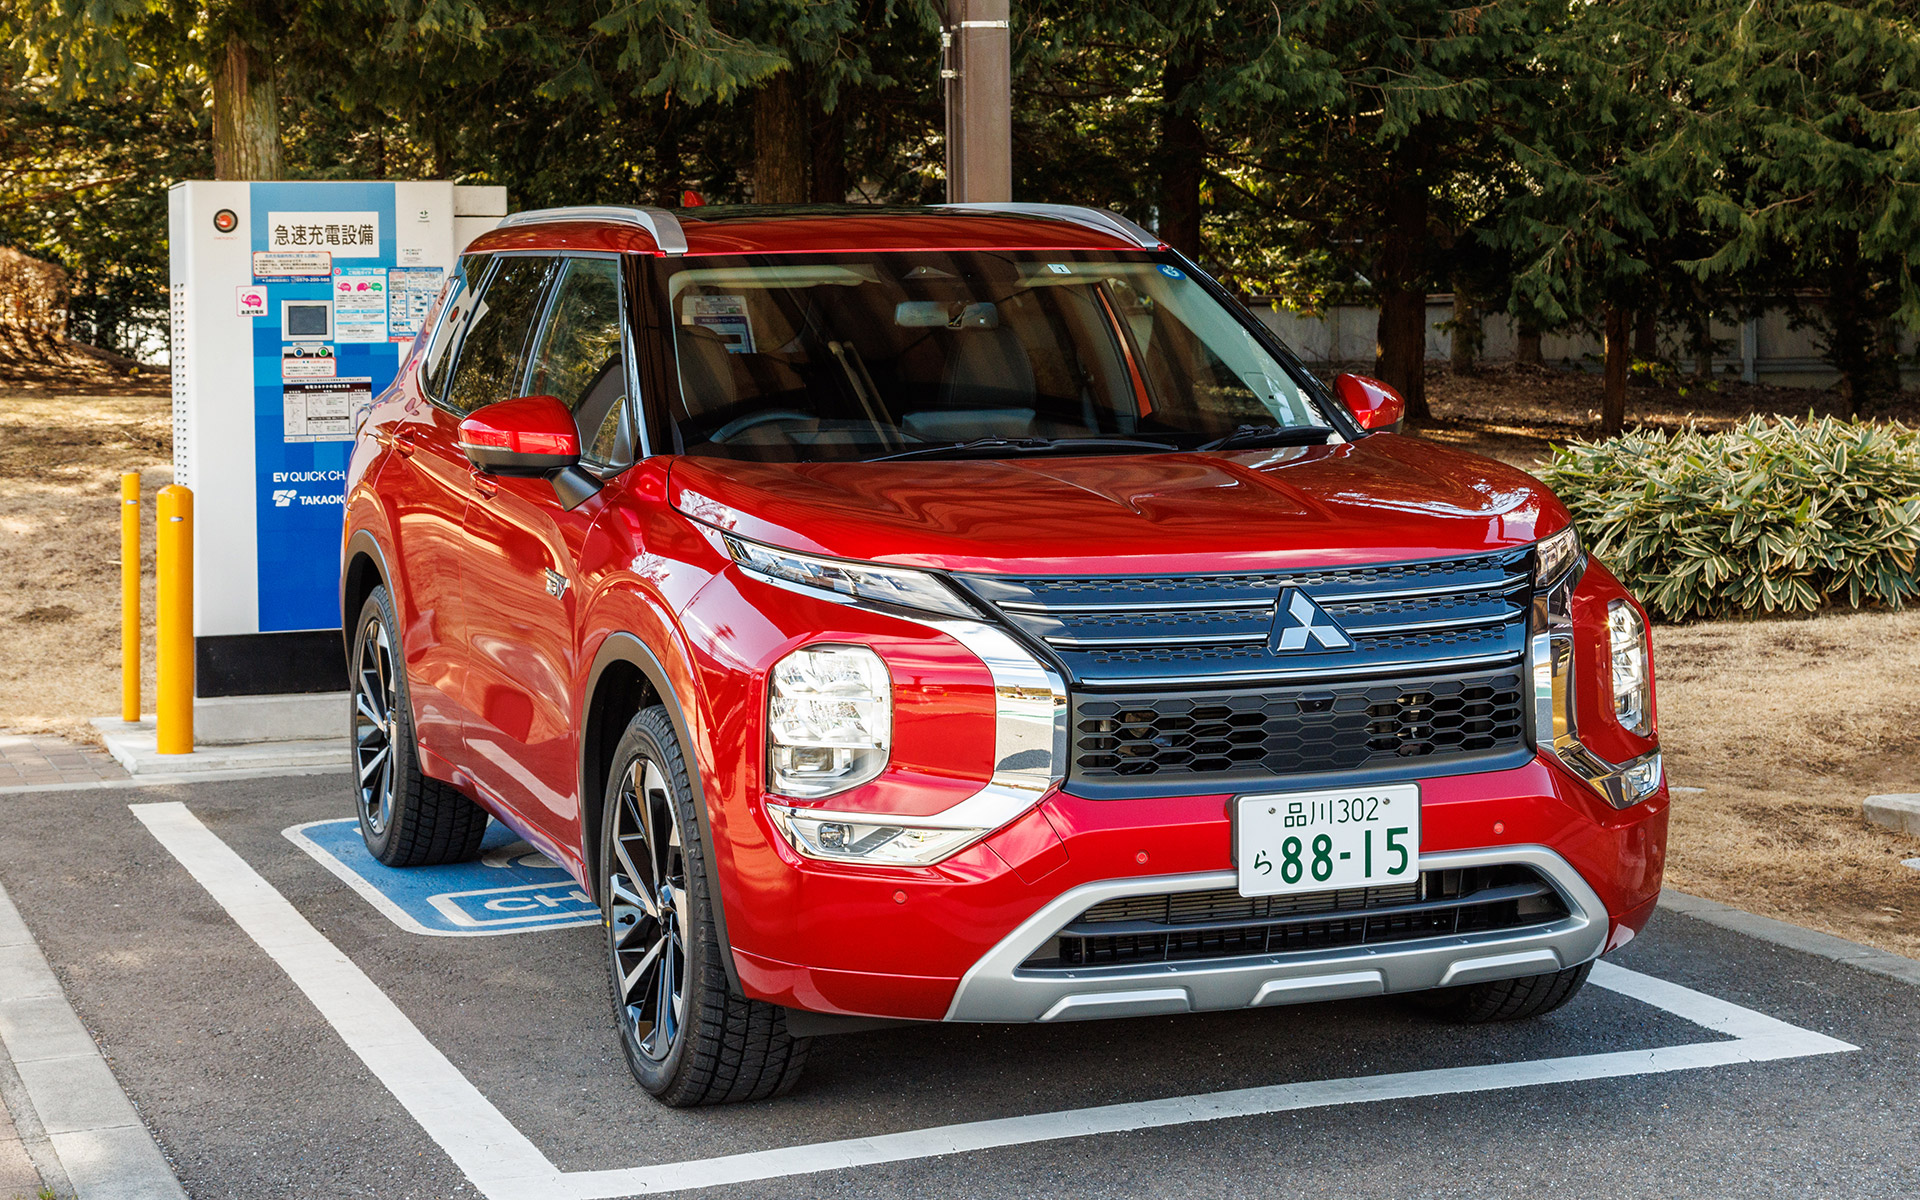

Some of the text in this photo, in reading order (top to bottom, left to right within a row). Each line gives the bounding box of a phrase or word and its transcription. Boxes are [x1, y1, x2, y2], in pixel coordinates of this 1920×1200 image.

[274, 224, 374, 246] 急速充電設備
[273, 470, 346, 482] EV QUICK CH
[1253, 826, 1409, 885] ら 88-15
